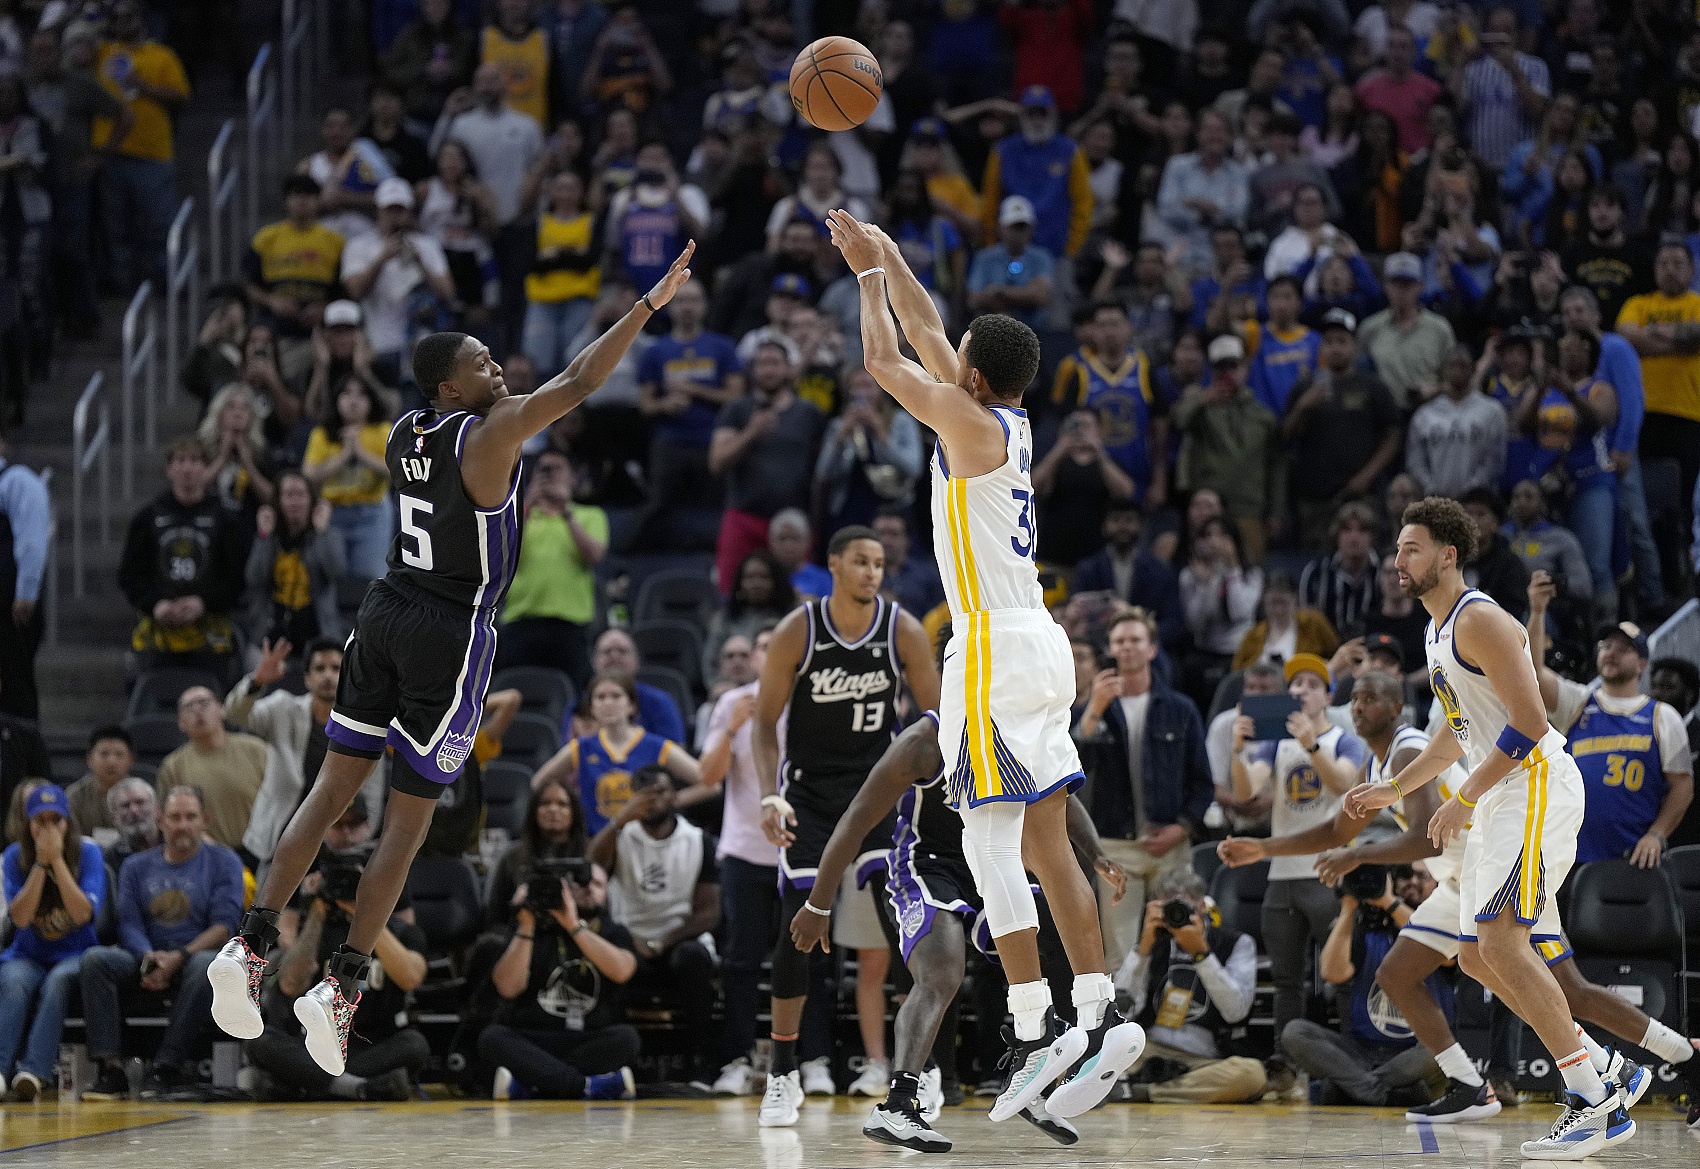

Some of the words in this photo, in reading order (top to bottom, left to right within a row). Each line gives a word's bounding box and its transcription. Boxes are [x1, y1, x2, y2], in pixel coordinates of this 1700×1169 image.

[400, 456, 433, 483] FOX
[399, 493, 434, 571] 5
[809, 666, 891, 703] Kings
[851, 701, 886, 732] 13
[440, 746, 467, 760] KINGS
[1602, 753, 1646, 792] 30
